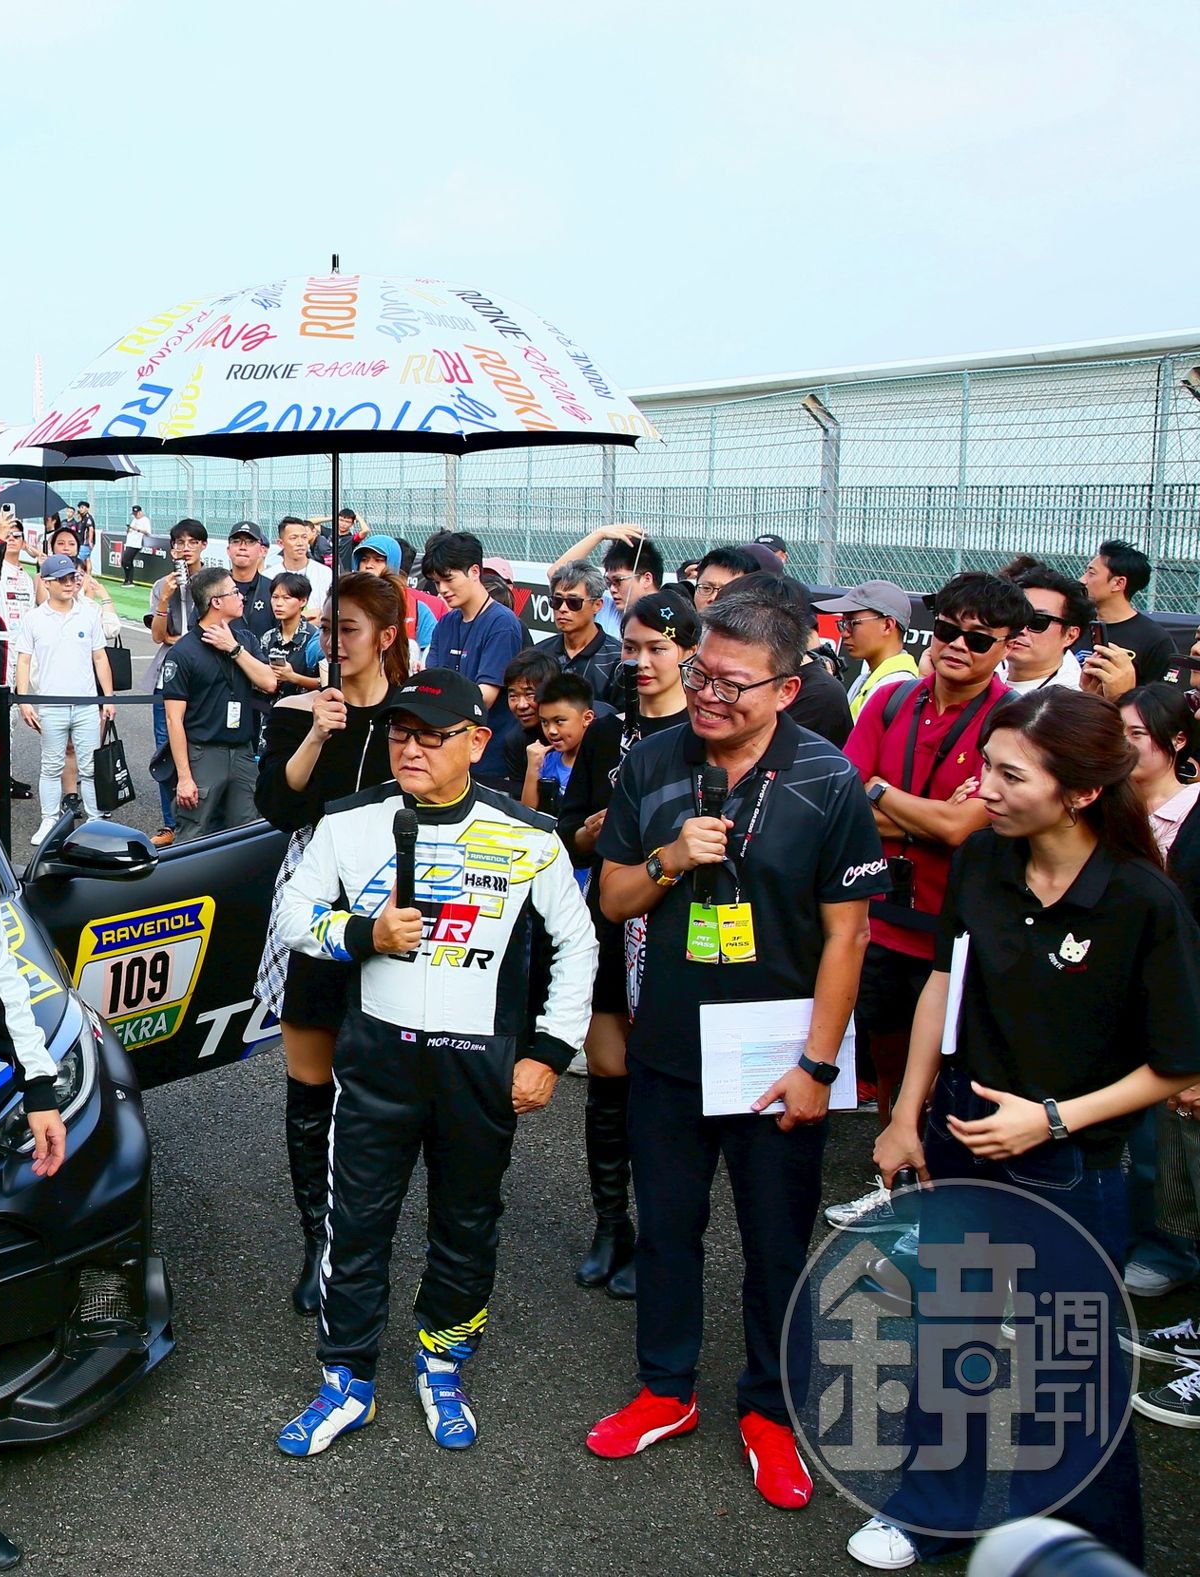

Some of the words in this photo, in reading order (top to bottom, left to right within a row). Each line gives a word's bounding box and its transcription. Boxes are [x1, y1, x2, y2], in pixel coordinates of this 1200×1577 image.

[447, 290, 532, 342] ROOKIE
[225, 362, 303, 380] ROOKIE
[304, 360, 390, 377] RACING
[756, 779, 770, 807] TOYOTA
[748, 807, 761, 833] GAZOO
[469, 853, 509, 864] RAVENOL
[464, 873, 492, 889] H&R
[102, 913, 196, 946] RAVENOL
[108, 951, 170, 1014] 109
[426, 1037, 471, 1050] MORIZO
